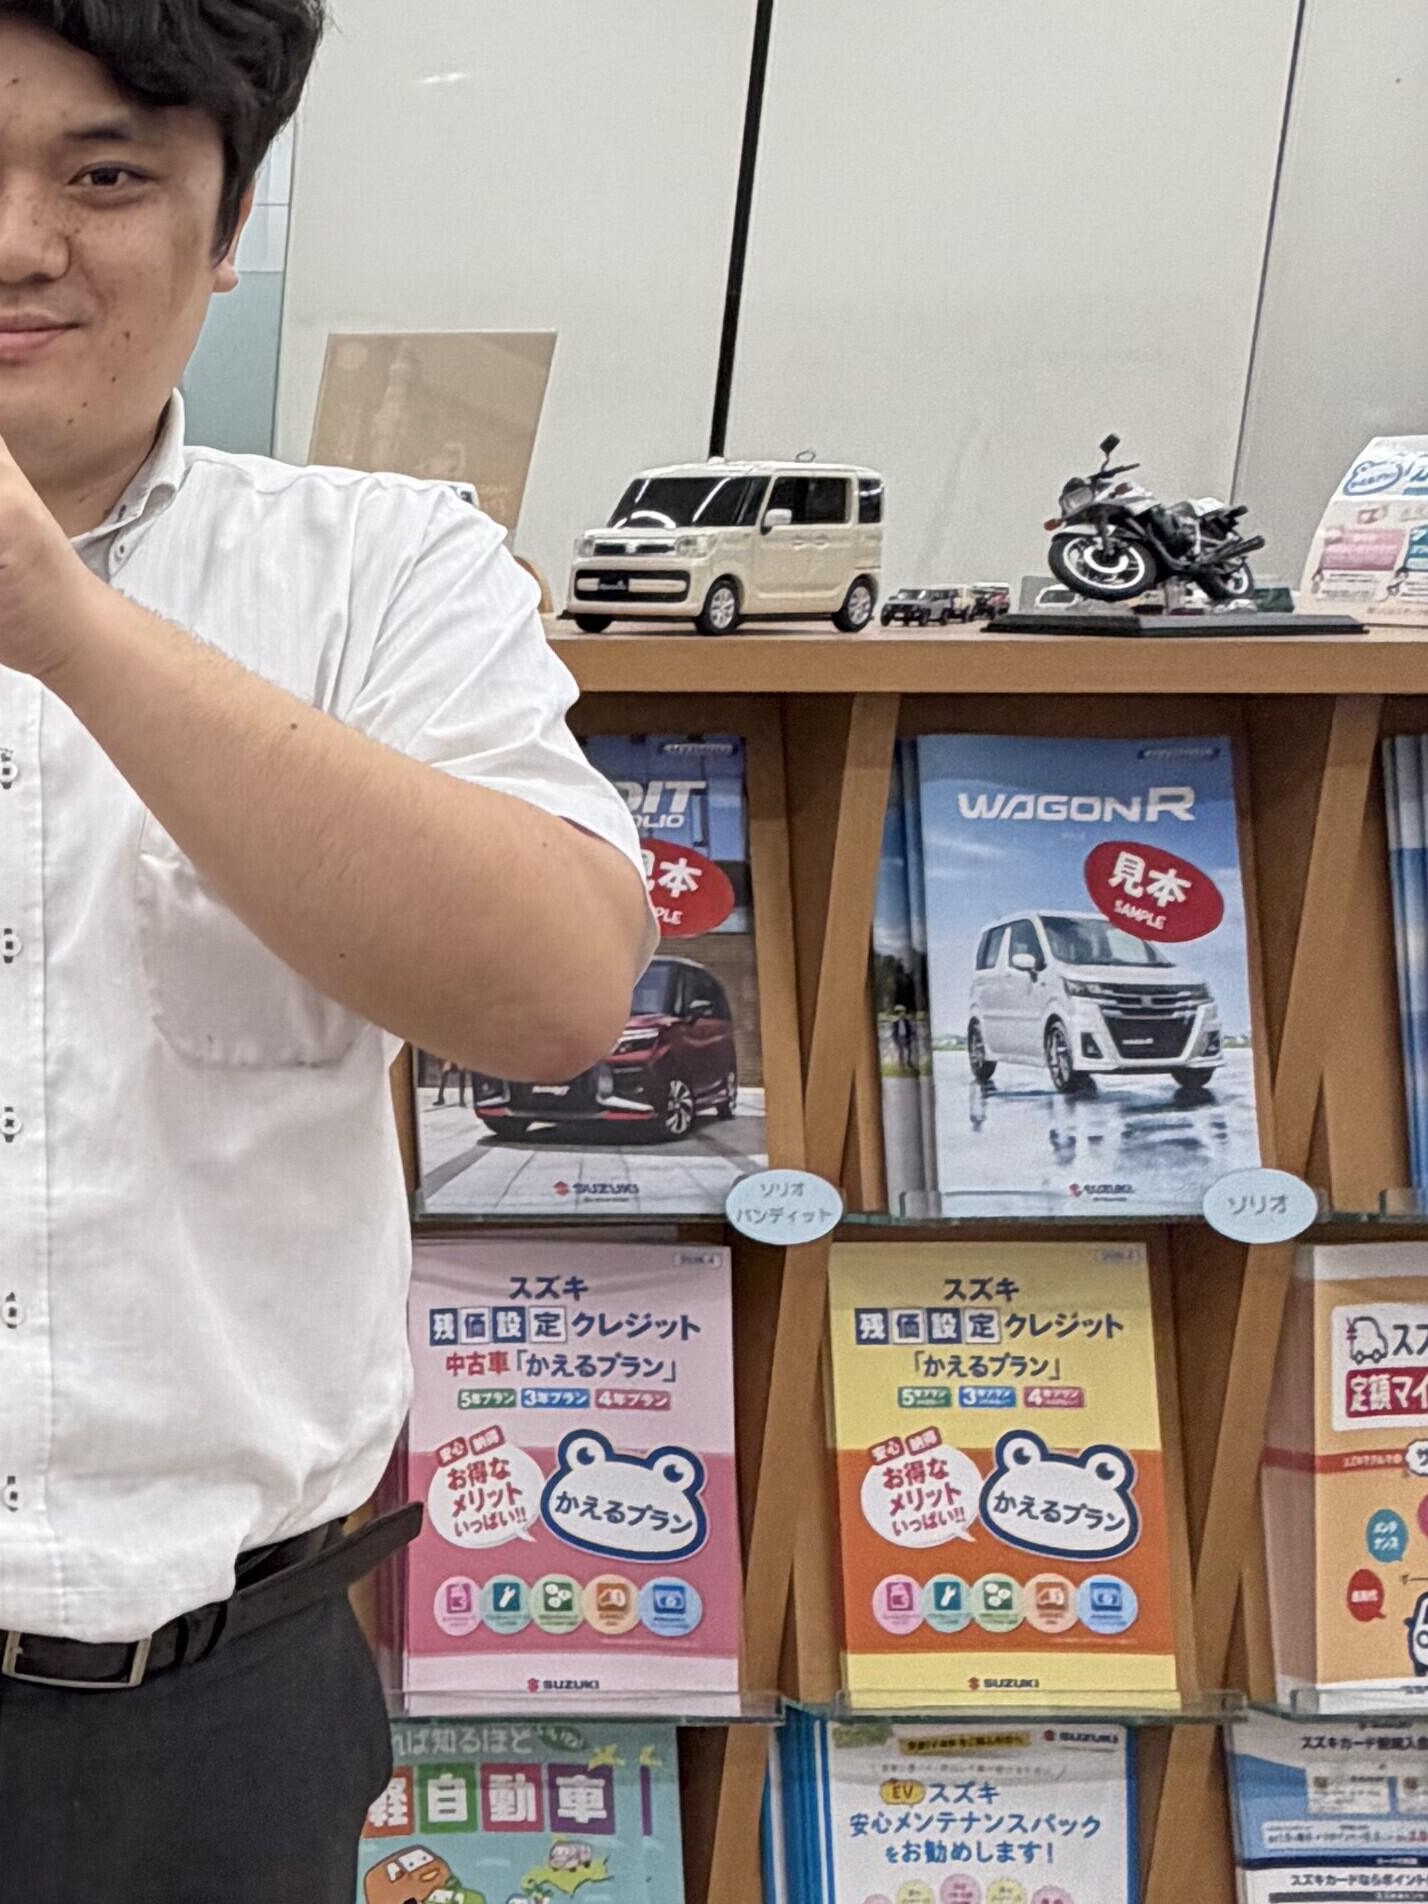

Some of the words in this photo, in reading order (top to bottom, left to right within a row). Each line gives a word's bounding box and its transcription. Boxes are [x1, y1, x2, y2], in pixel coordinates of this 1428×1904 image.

[614, 781, 706, 813] DIT
[1107, 851, 1193, 908] 見本
[1113, 899, 1167, 931] SAMPLE
[760, 1183, 805, 1197] ソリオ
[1228, 1195, 1289, 1214] ソリオ
[736, 1207, 833, 1224] バンディット
[509, 1275, 590, 1301] スズキ
[944, 1276, 1020, 1302] スズキ
[446, 1349, 677, 1383] 中古車「かえるプラン」
[914, 1350, 1061, 1381] 「かえるプラン」
[447, 1457, 511, 1491] お得な
[882, 1457, 949, 1490] お得な
[452, 1482, 523, 1518] メリット
[555, 1490, 693, 1534] かえるプラン
[889, 1481, 962, 1517] メリット
[993, 1490, 1126, 1533] かえるプラン
[543, 1679, 600, 1690] SUZUKI
[983, 1678, 1040, 1689] SUZUKI
[891, 1784, 914, 1800] EV
[928, 1780, 1000, 1805] スズキ
[849, 1811, 1102, 1838] 安心メンテナンスパック
